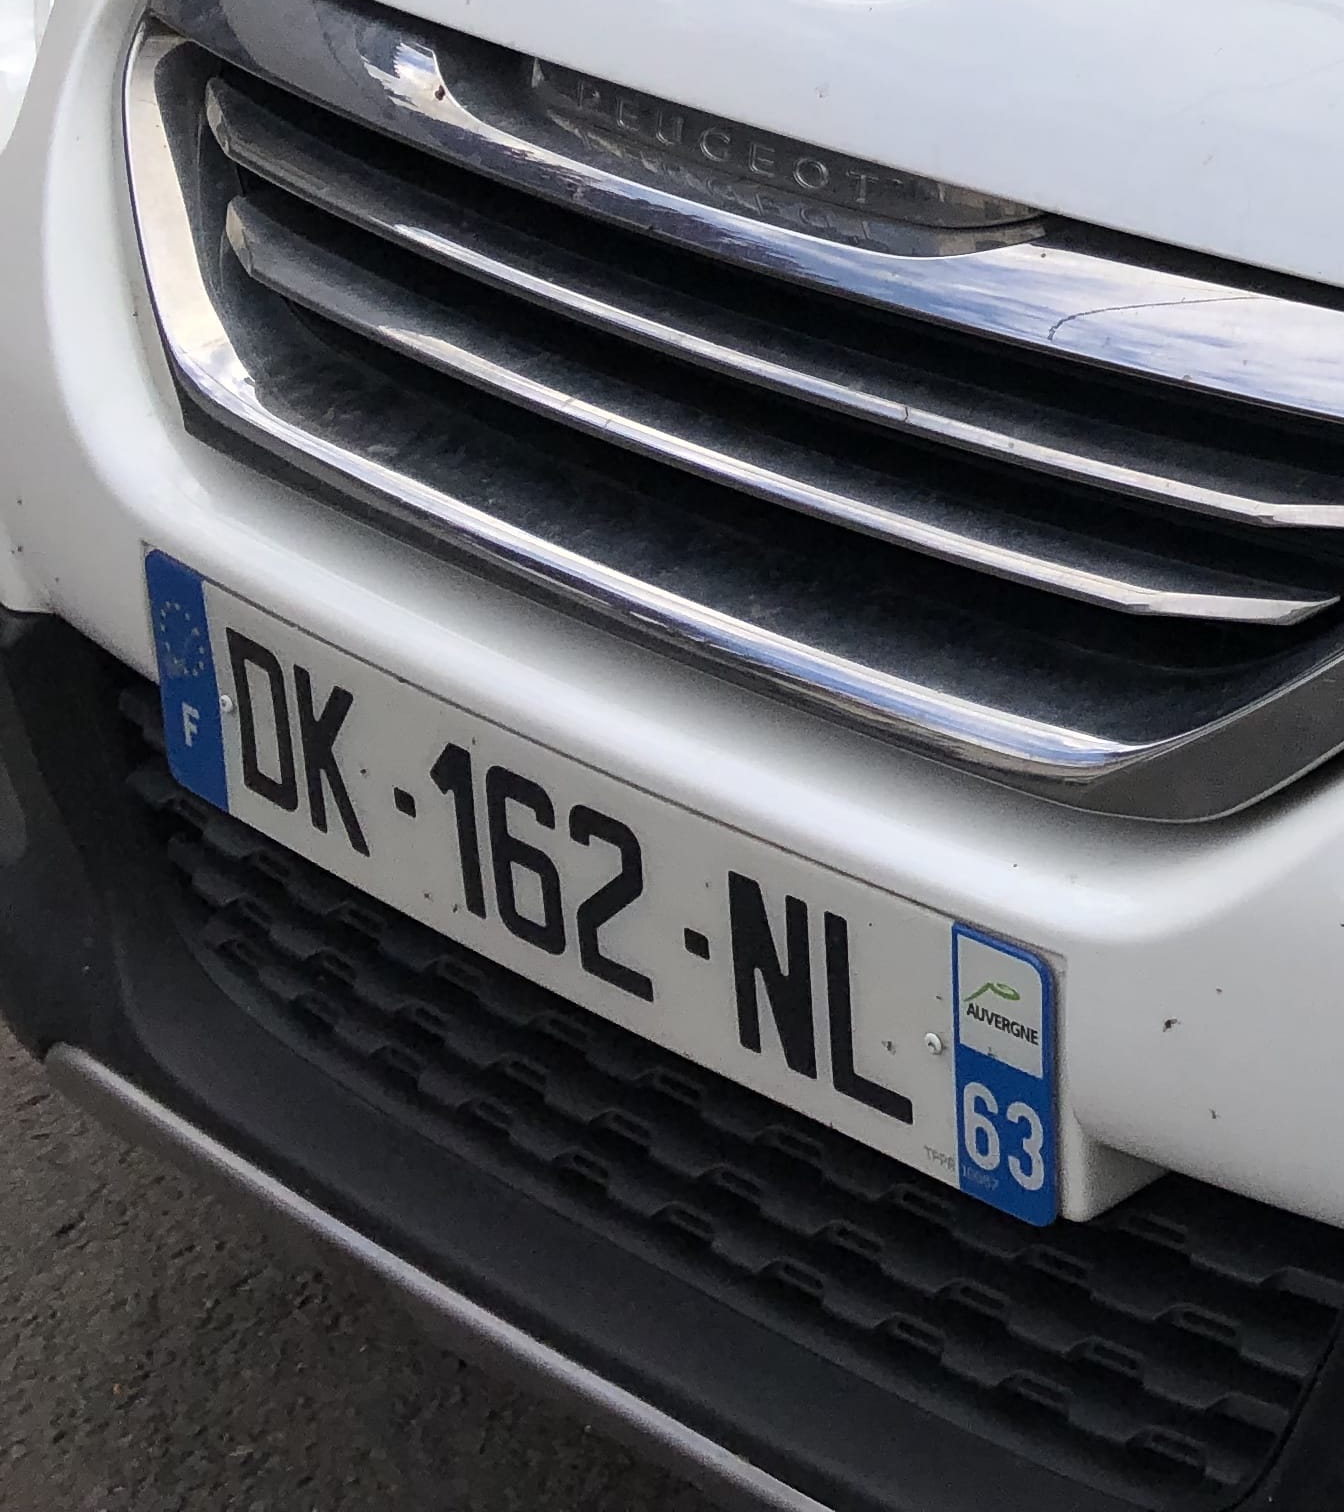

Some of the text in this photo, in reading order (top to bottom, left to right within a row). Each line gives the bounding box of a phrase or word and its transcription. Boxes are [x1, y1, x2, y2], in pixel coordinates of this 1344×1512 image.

[577, 79, 880, 204] PEUGEOT
[182, 700, 200, 748] F
[966, 1002, 1040, 1046] AUVERGNE
[963, 1081, 1045, 1191] 63
